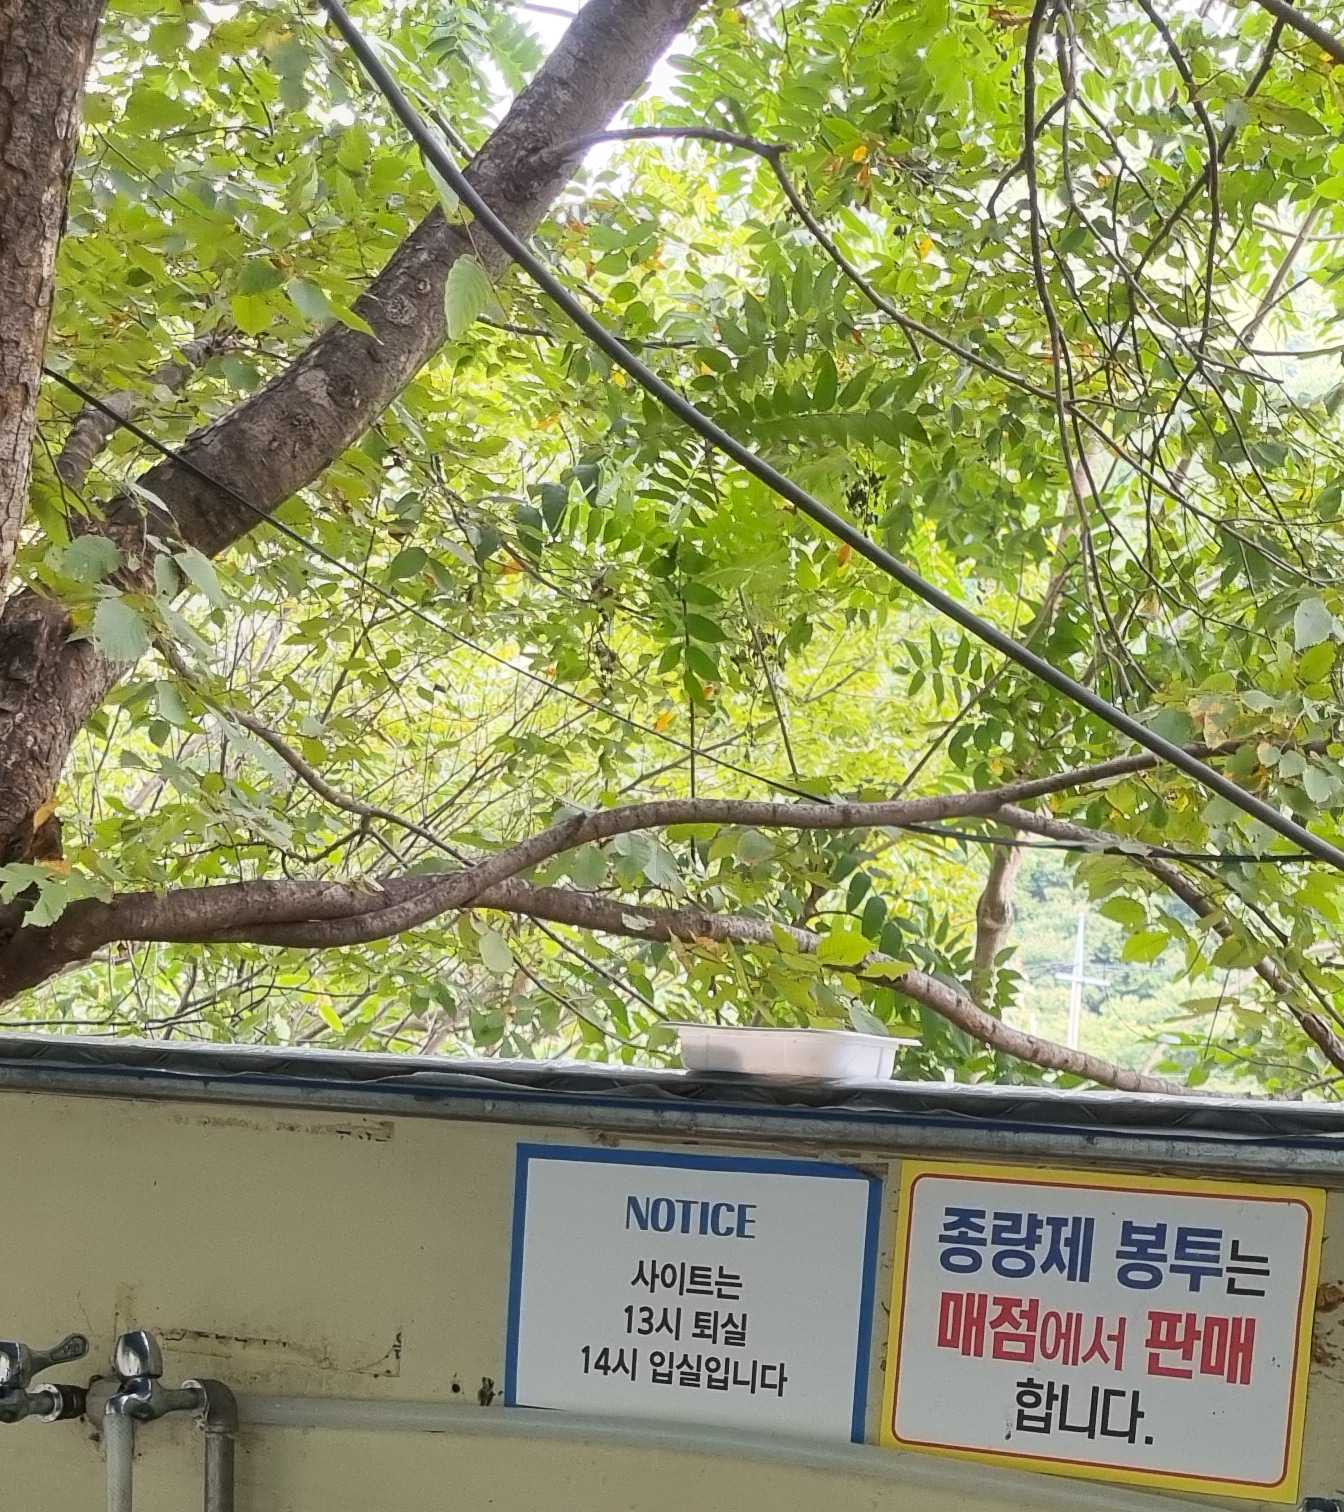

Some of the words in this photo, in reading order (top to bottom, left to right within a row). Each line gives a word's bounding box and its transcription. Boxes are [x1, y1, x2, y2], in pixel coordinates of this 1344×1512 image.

[626, 1196, 757, 1239] NOTICE
[939, 1207, 1095, 1283] 종량제
[1116, 1221, 1271, 1298] 봉투는
[631, 1260, 743, 1301] 사이트는
[624, 1305, 682, 1341] 13시
[692, 1311, 748, 1347] 퇴실
[937, 1292, 1127, 1372] 매점에서
[1145, 1311, 1256, 1386] 판매
[582, 1346, 638, 1382] 14시
[650, 1350, 788, 1397] 입실입니다
[1016, 1377, 1155, 1445] 합니다.
